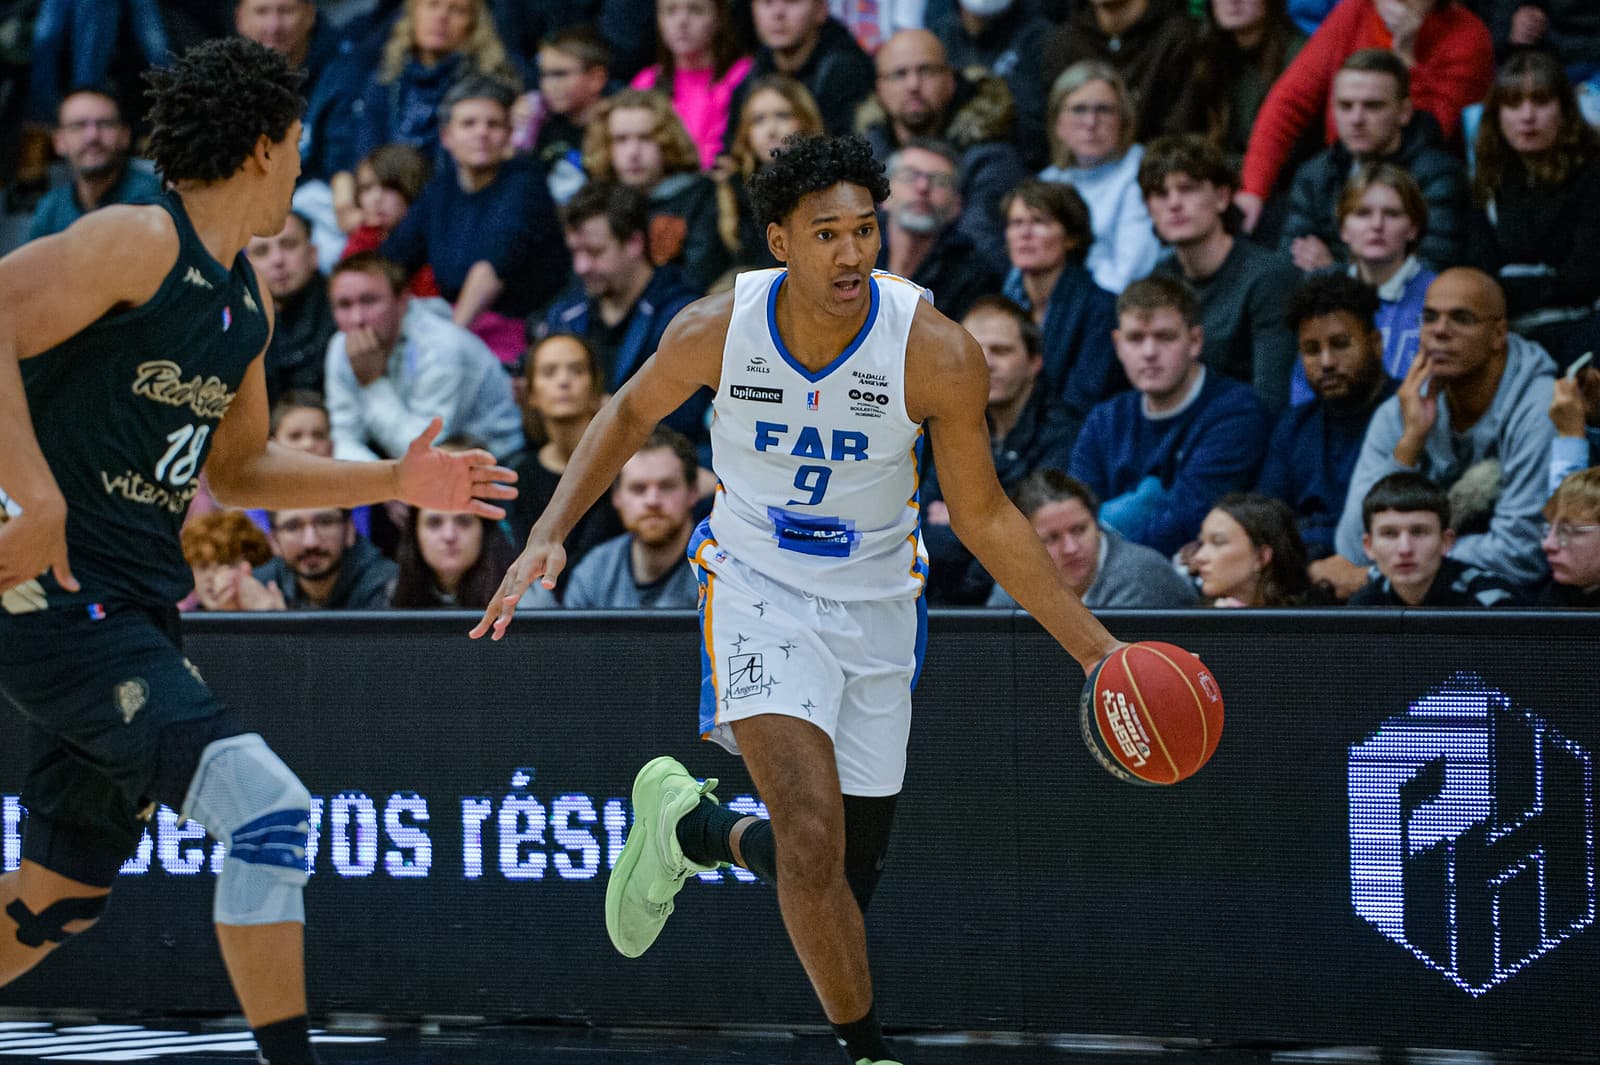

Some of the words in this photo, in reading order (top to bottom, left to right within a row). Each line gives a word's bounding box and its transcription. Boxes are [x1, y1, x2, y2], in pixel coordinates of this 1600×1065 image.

[746, 365, 770, 374] SKILLS
[786, 465, 833, 506] 9
[733, 685, 759, 696] Angers
[1102, 689, 1146, 767] LEGACY
